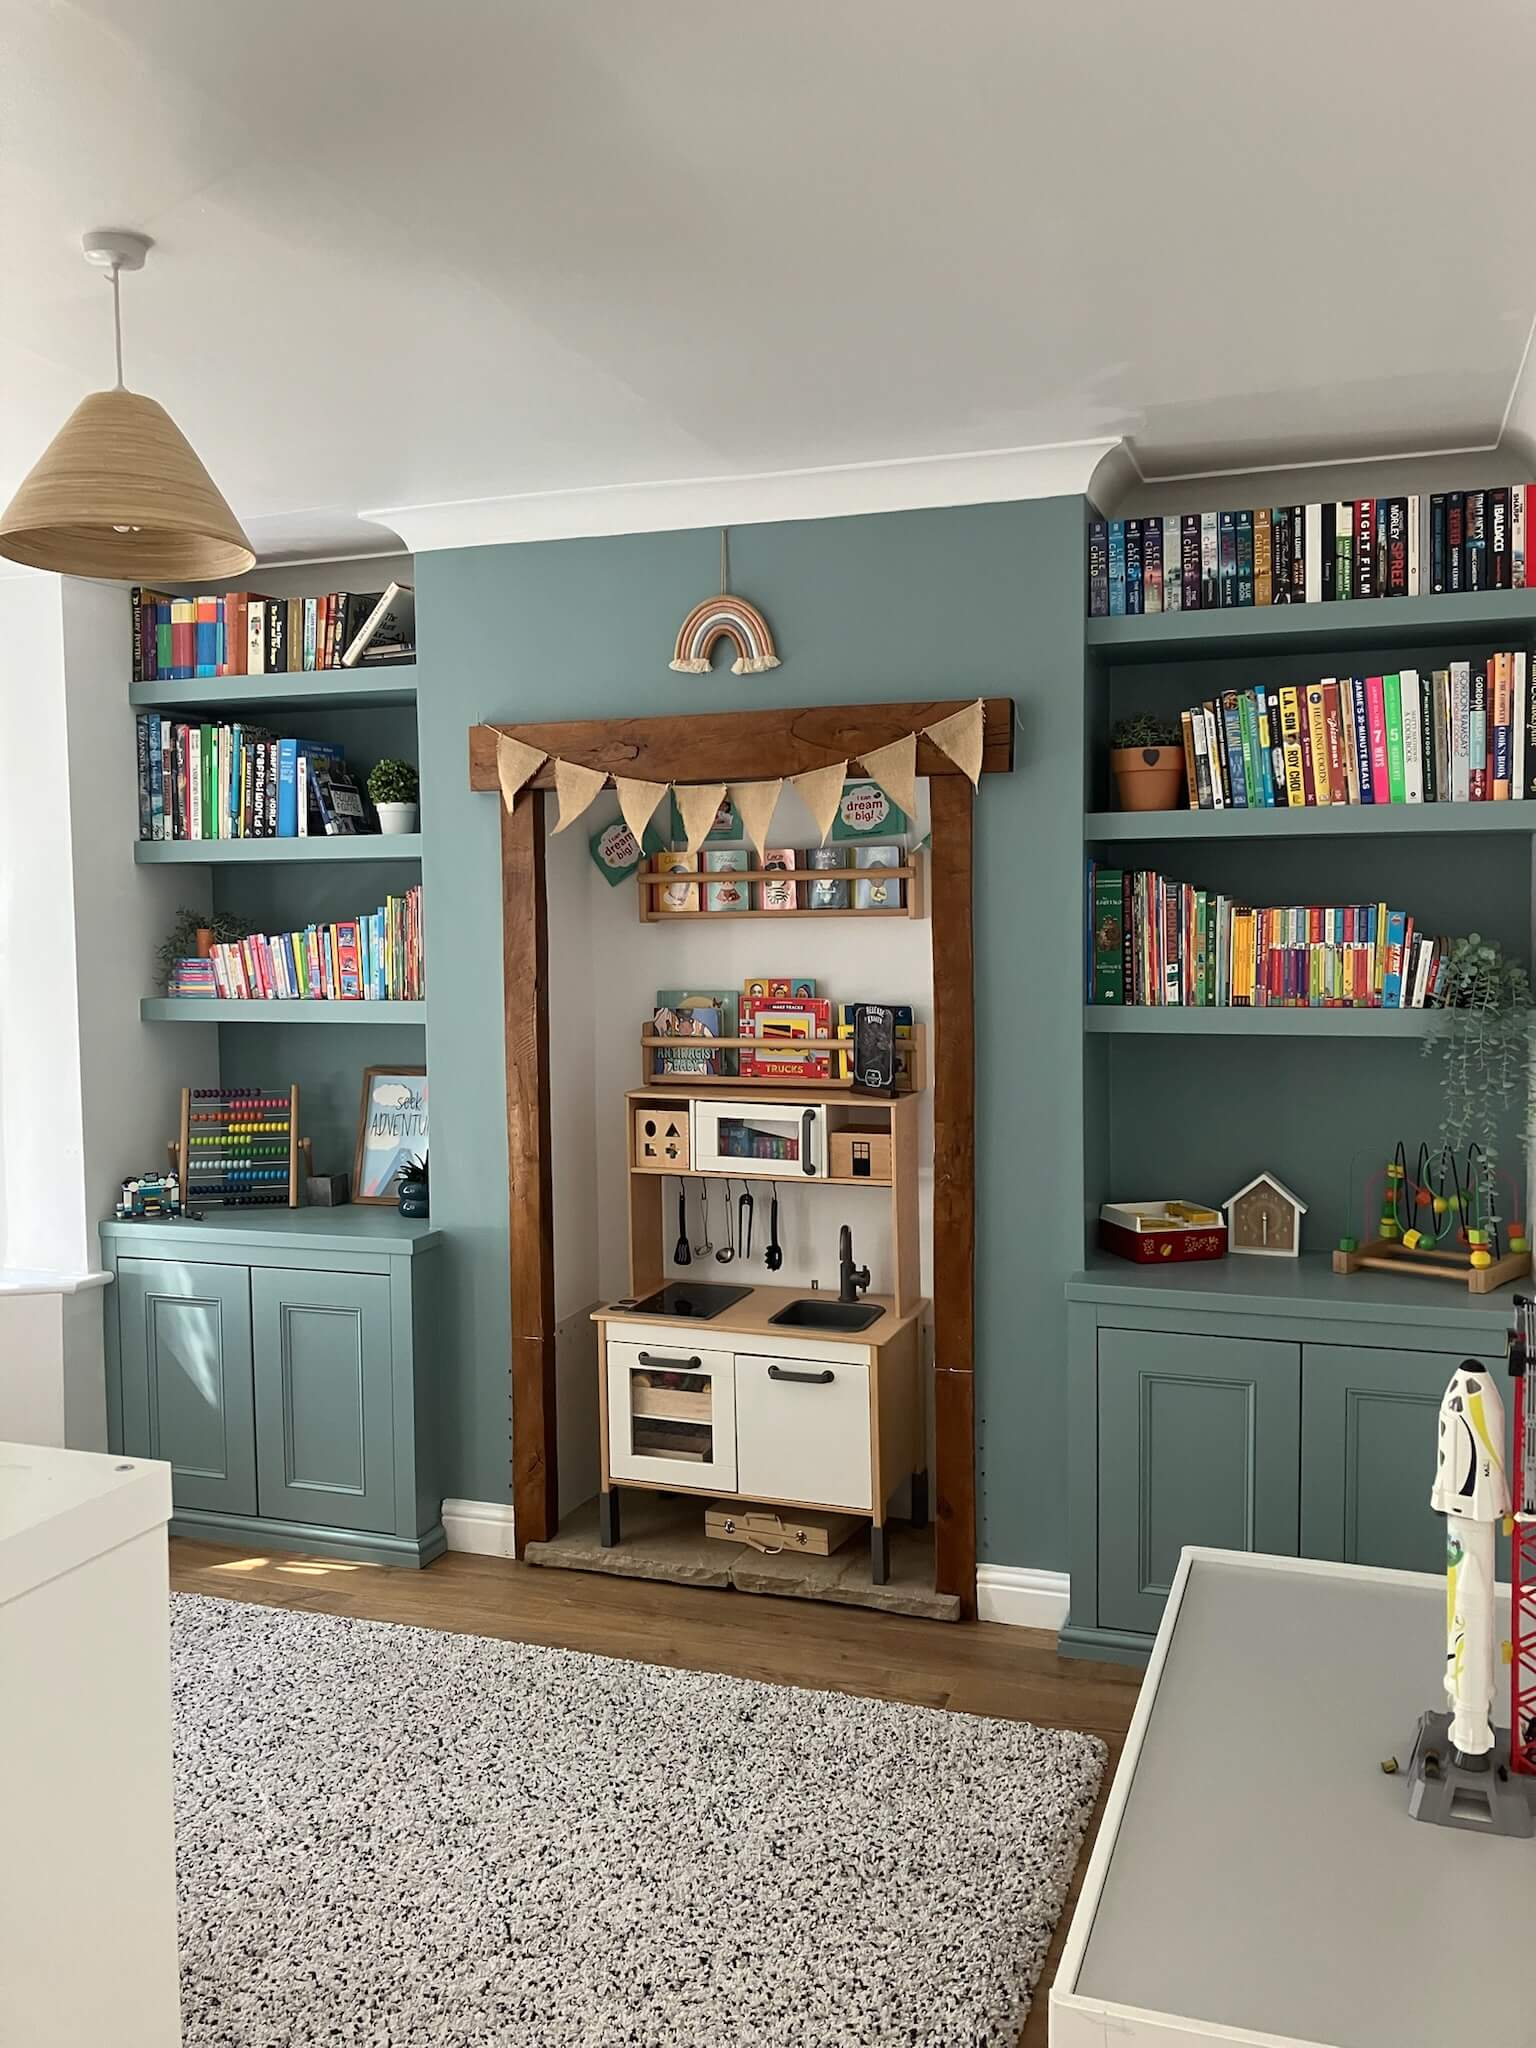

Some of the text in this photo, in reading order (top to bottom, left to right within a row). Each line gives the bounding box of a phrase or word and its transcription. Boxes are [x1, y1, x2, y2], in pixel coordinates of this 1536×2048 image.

[1390, 504, 1404, 587] MORLEY SPREE
[1494, 508, 1505, 553] BALDACCI
[1091, 546, 1099, 576] CHILD
[1109, 543, 1117, 574] CHILD
[1127, 543, 1135, 574] CHILD
[1145, 541, 1153, 572] CHILD
[1183, 539, 1192, 569] CHILD
[1255, 534, 1263, 565] CHILD
[1360, 502, 1371, 594] NIGHT FILM
[1474, 676, 1485, 711] GORDON
[1460, 670, 1469, 757] GORDON RAMSAY'S
[1283, 690, 1302, 793] L.A. SON ROY CHOI
[1312, 706, 1328, 784] HEALING FOODS
[1354, 679, 1365, 714] JAMIE'S
[1360, 760, 1371, 790] MEALS
[1389, 727, 1399, 742] 5
[1497, 726, 1507, 755] COOK'S
[1374, 746, 1385, 768] WAYS
[1497, 756, 1507, 778] BOOK
[847, 801, 883, 811] dream
[855, 810, 874, 822] big!
[605, 832, 634, 857] dream
[616, 843, 633, 860] big!
[1167, 902, 1178, 962] MOUNTAIN
[657, 1048, 719, 1060] ANTIRACIST
[766, 1064, 803, 1074] TRUCKS
[396, 1091, 422, 1111] seek
[370, 1112, 429, 1137] ADVENTU
